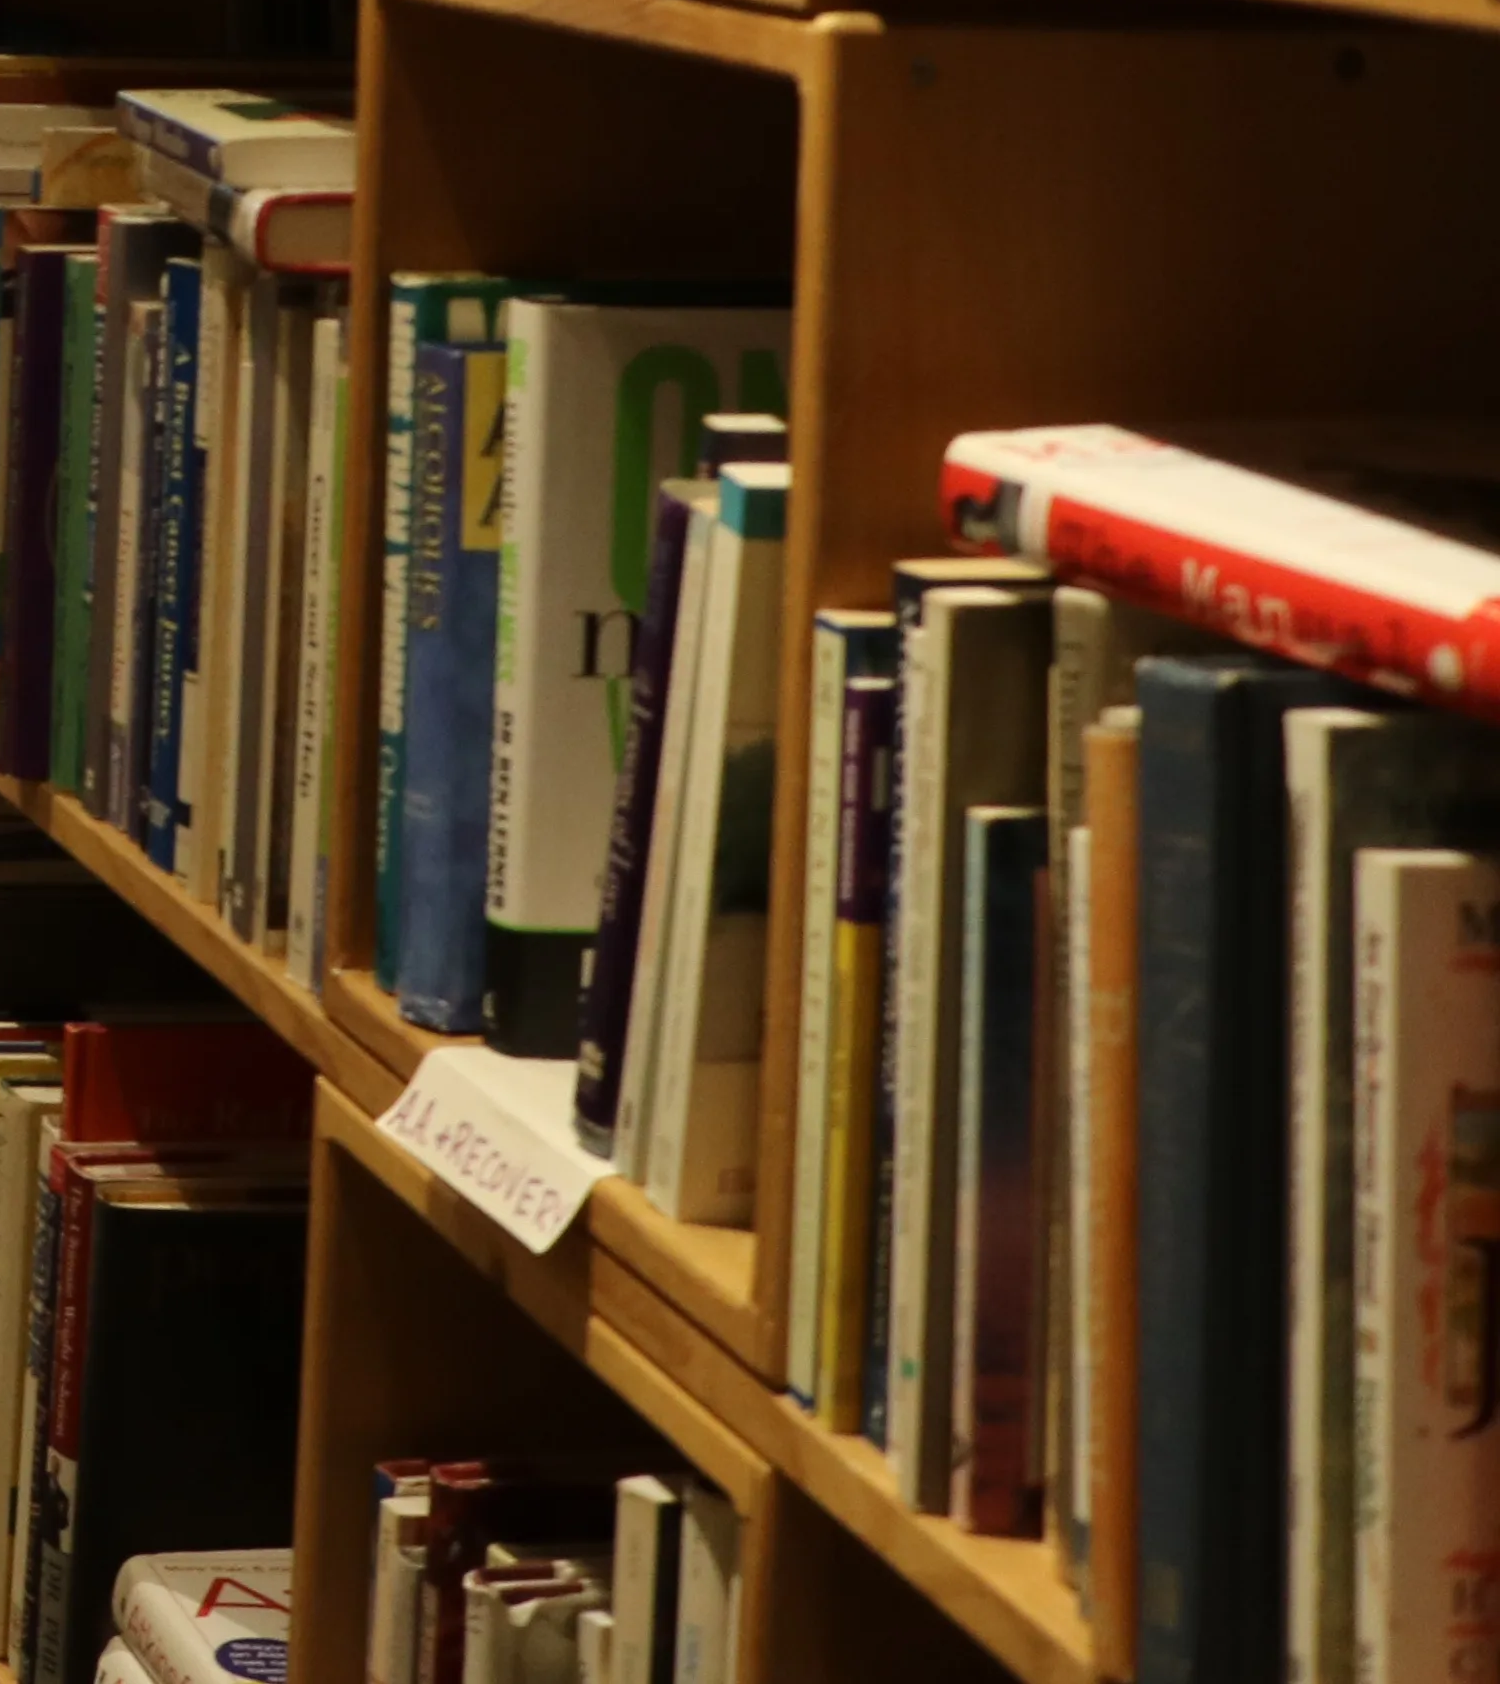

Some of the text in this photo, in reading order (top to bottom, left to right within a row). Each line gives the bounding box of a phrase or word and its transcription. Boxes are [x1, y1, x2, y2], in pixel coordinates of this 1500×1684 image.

[169, 380, 190, 484] Breast
[163, 495, 186, 607] Cancer
[380, 302, 416, 734] MORE THAN WINNING
[416, 373, 450, 631] ALCOHOLICS
[294, 475, 327, 800] Cancer and Self-Help
[497, 542, 520, 686] WELLNESS
[156, 618, 182, 742] Journey
[497, 709, 515, 746] DR.
[494, 755, 514, 807] BEN
[490, 813, 512, 910] LERNER
[386, 1088, 435, 1147] AA
[68, 1185, 82, 1219] The
[59, 1306, 77, 1362] Weight
